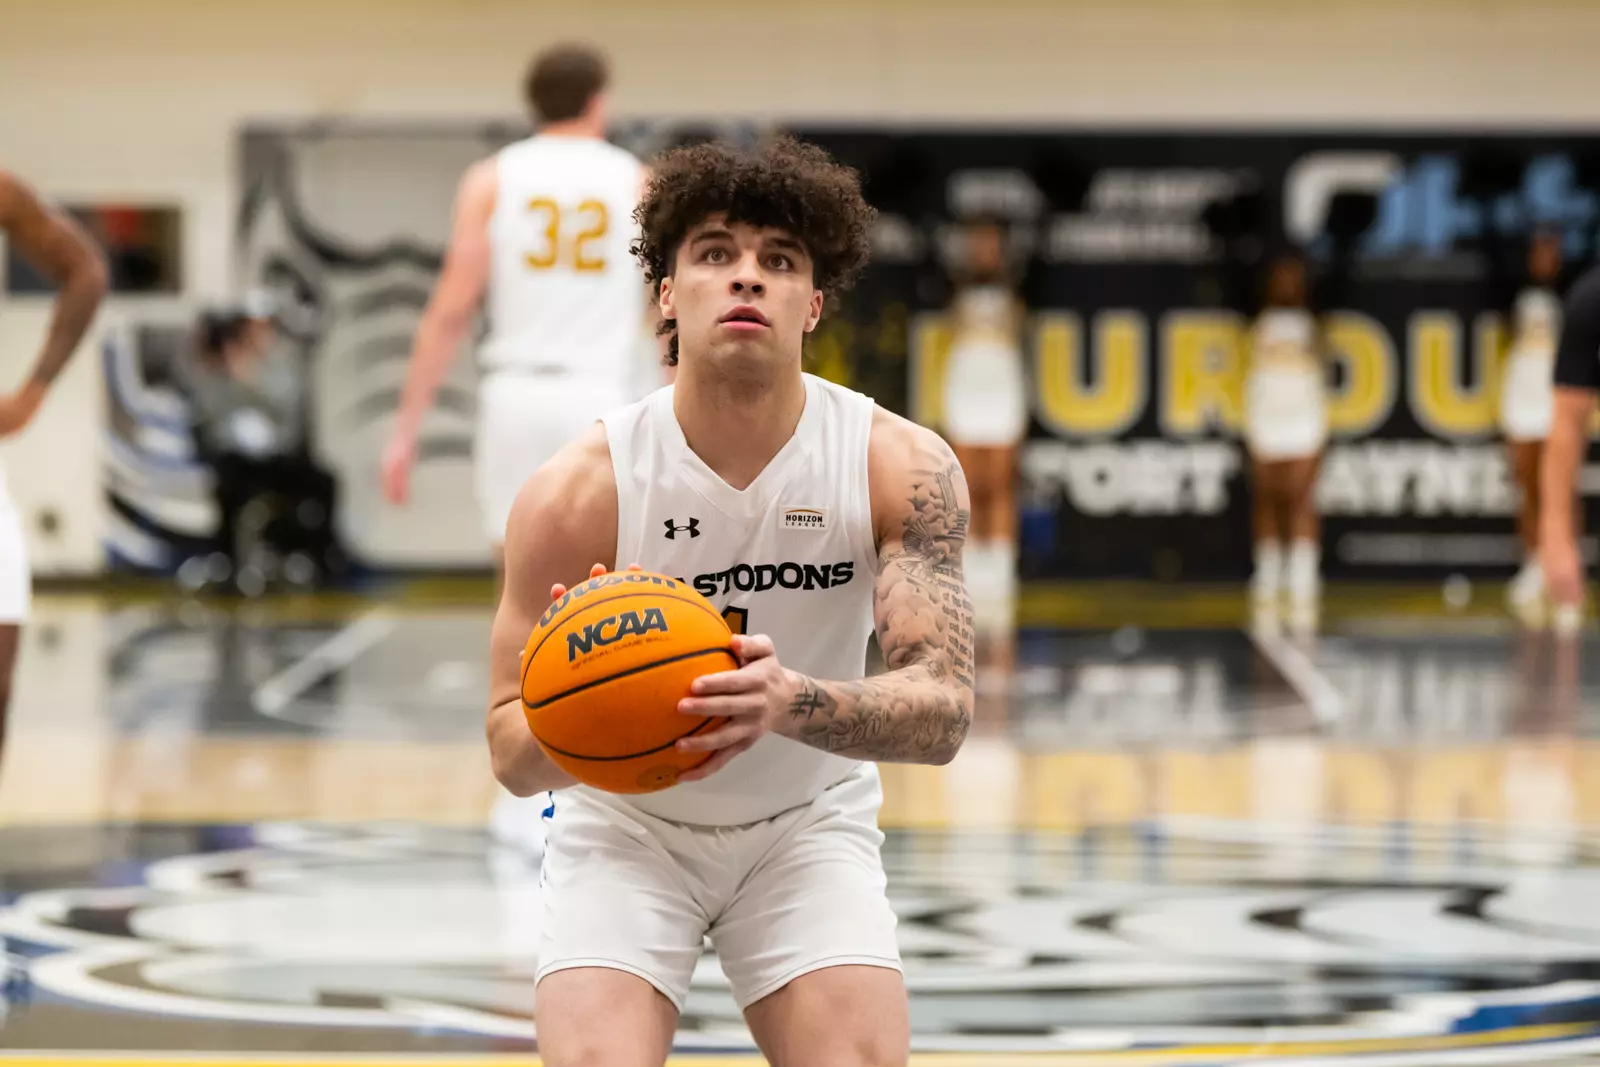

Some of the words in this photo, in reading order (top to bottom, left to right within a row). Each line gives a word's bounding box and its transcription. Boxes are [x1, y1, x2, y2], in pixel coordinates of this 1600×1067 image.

[524, 197, 609, 273] 32
[785, 514, 823, 523] HORIZON
[539, 573, 677, 628] Wilson
[677, 561, 854, 598] STODONS
[566, 607, 669, 662] NCAA
